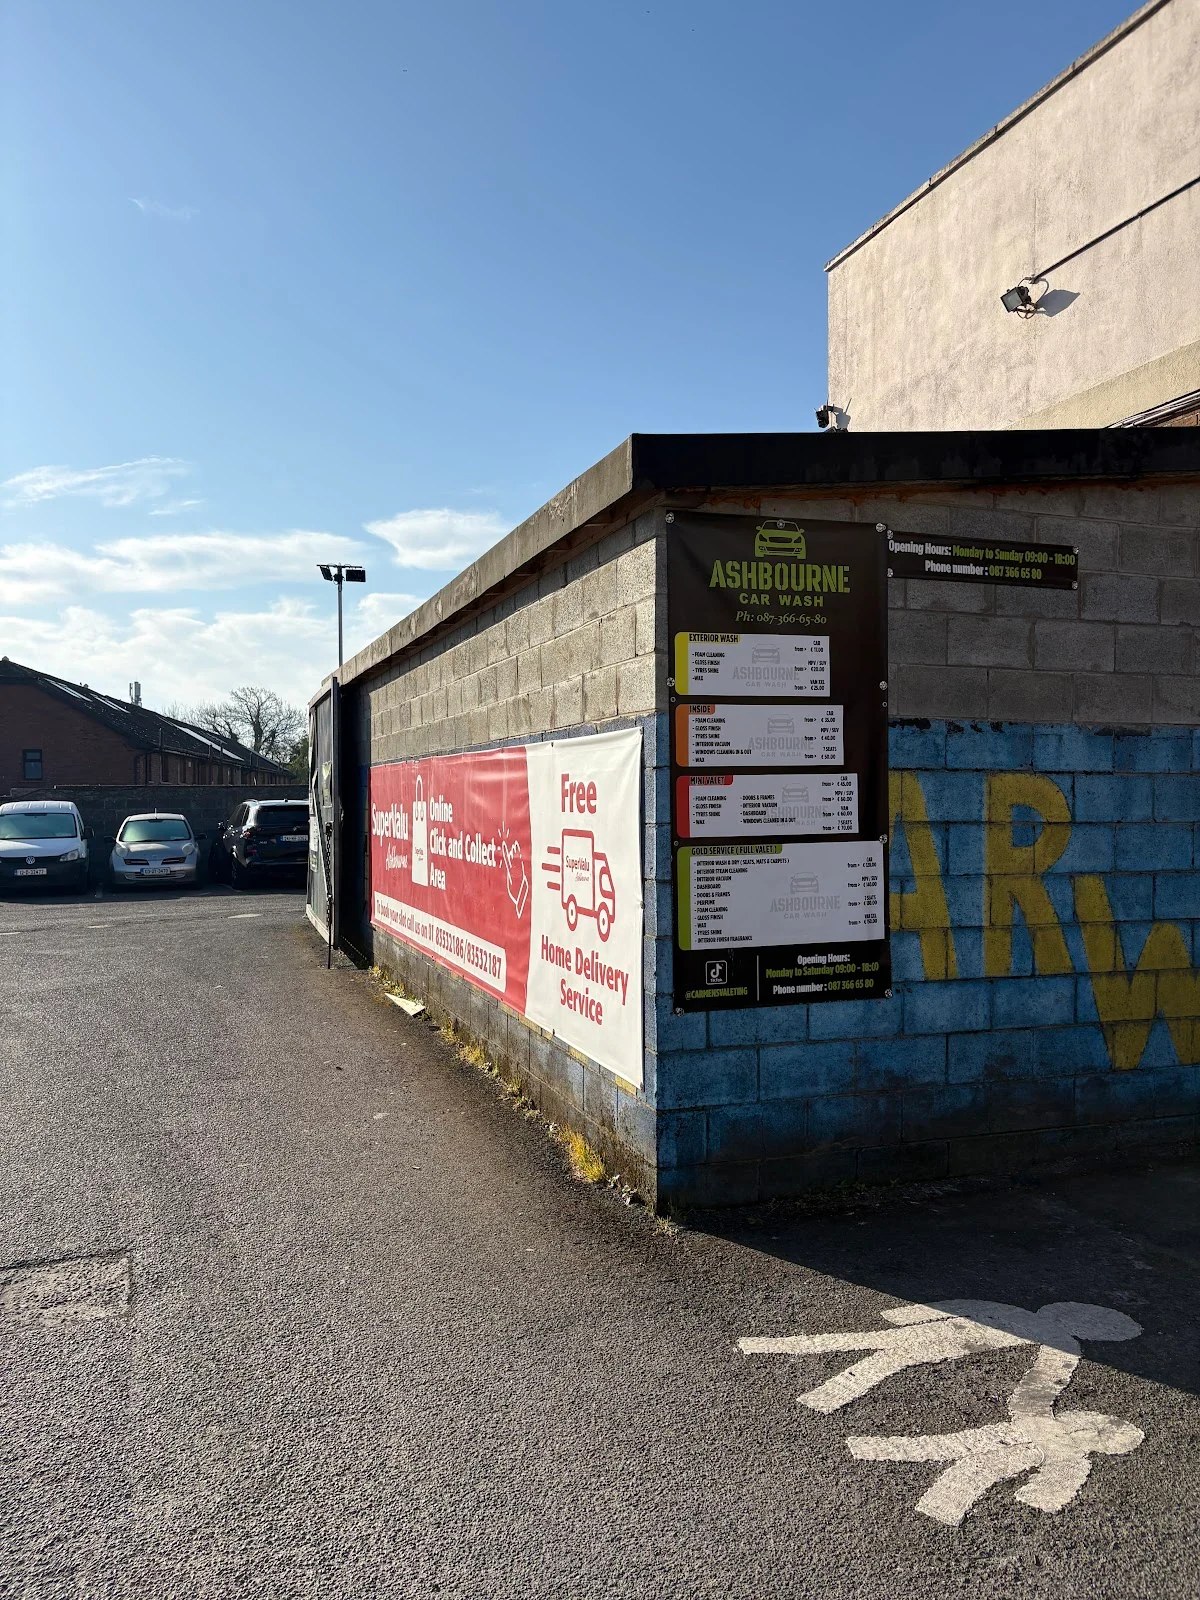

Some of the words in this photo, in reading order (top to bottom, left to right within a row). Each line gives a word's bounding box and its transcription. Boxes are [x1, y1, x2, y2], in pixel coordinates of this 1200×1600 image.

[889, 540, 924, 556] Opening
[925, 542, 951, 556] Hours:
[953, 545, 984, 560] Monday
[985, 548, 993, 560] to
[995, 549, 1024, 564] Sunday
[1025, 550, 1048, 564] 09:00
[1054, 553, 1076, 566] 18:00
[708, 559, 851, 593] ASHBOURNE
[925, 560, 951, 573] Phone
[952, 563, 984, 576] number
[989, 565, 1003, 578] 087
[1005, 566, 1019, 578] 366
[1021, 567, 1030, 579] 65
[1031, 567, 1042, 580] 80
[739, 592, 770, 605] CAR
[779, 594, 824, 607] WASH
[735, 611, 754, 622] Ph:
[757, 612, 827, 626] 087-366-65-80
[689, 634, 719, 642] EXTERIOR
[720, 634, 739, 642] WASH
[732, 666, 799, 680] ASHBOURNE
[748, 737, 814, 750] ASHBOURNE
[690, 776, 705, 784] MINI
[705, 776, 724, 784] VALET
[561, 773, 597, 813] Free
[430, 794, 453, 823] Online
[372, 803, 408, 847] SuperValu
[430, 827, 447, 856] Click
[448, 831, 463, 860] and
[465, 832, 496, 867] Collect
[691, 846, 708, 855] GOLD
[709, 846, 735, 855] SERVICE
[740, 846, 753, 854] FULL
[755, 845, 773, 854] VALET
[430, 862, 446, 890] Area
[770, 896, 840, 913] ASHBOURNE
[390, 908, 398, 925] your
[399, 909, 407, 928] slot
[407, 914, 415, 933] call
[415, 921, 420, 935] us
[421, 924, 427, 939] on
[803, 911, 827, 919] WASH
[797, 954, 827, 966] Opening
[828, 953, 850, 963] Hours:
[541, 934, 571, 971] Home
[575, 947, 629, 1006] Delivery
[766, 968, 793, 979] Monday
[795, 967, 802, 976] to
[803, 965, 834, 976] Saturday
[835, 963, 856, 974] 09:00
[862, 961, 879, 972] 18:00
[773, 985, 795, 995] Phone
[796, 982, 823, 993] number
[828, 981, 841, 991] 087
[842, 980, 854, 989] 366
[855, 980, 864, 988] 65
[865, 978, 874, 988] 80
[560, 978, 603, 1025] Service
